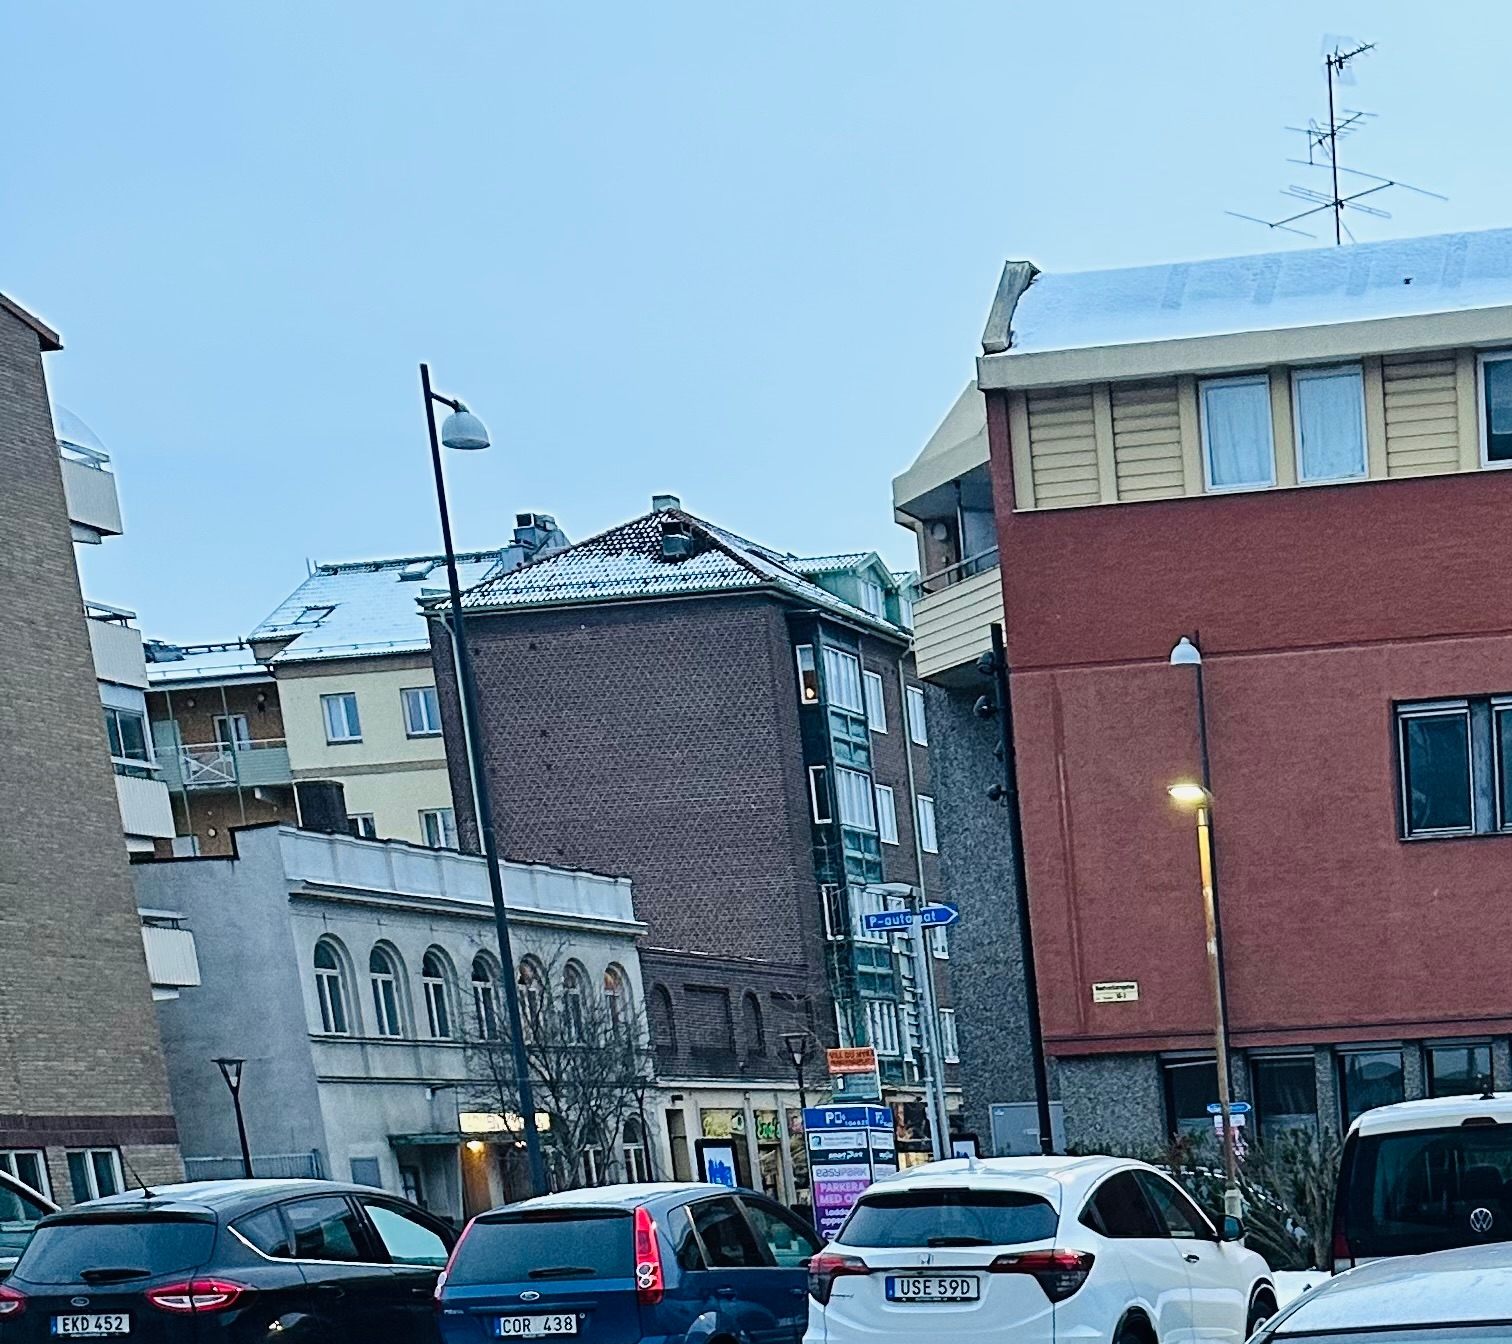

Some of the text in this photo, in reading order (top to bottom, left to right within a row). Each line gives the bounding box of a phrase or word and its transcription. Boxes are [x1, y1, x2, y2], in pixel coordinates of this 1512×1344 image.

[869, 910, 936, 927] P-autoat
[900, 1279, 970, 1295] USE 59D
[62, 1315, 123, 1332] EKD 452
[503, 1315, 573, 1334] COR 438
